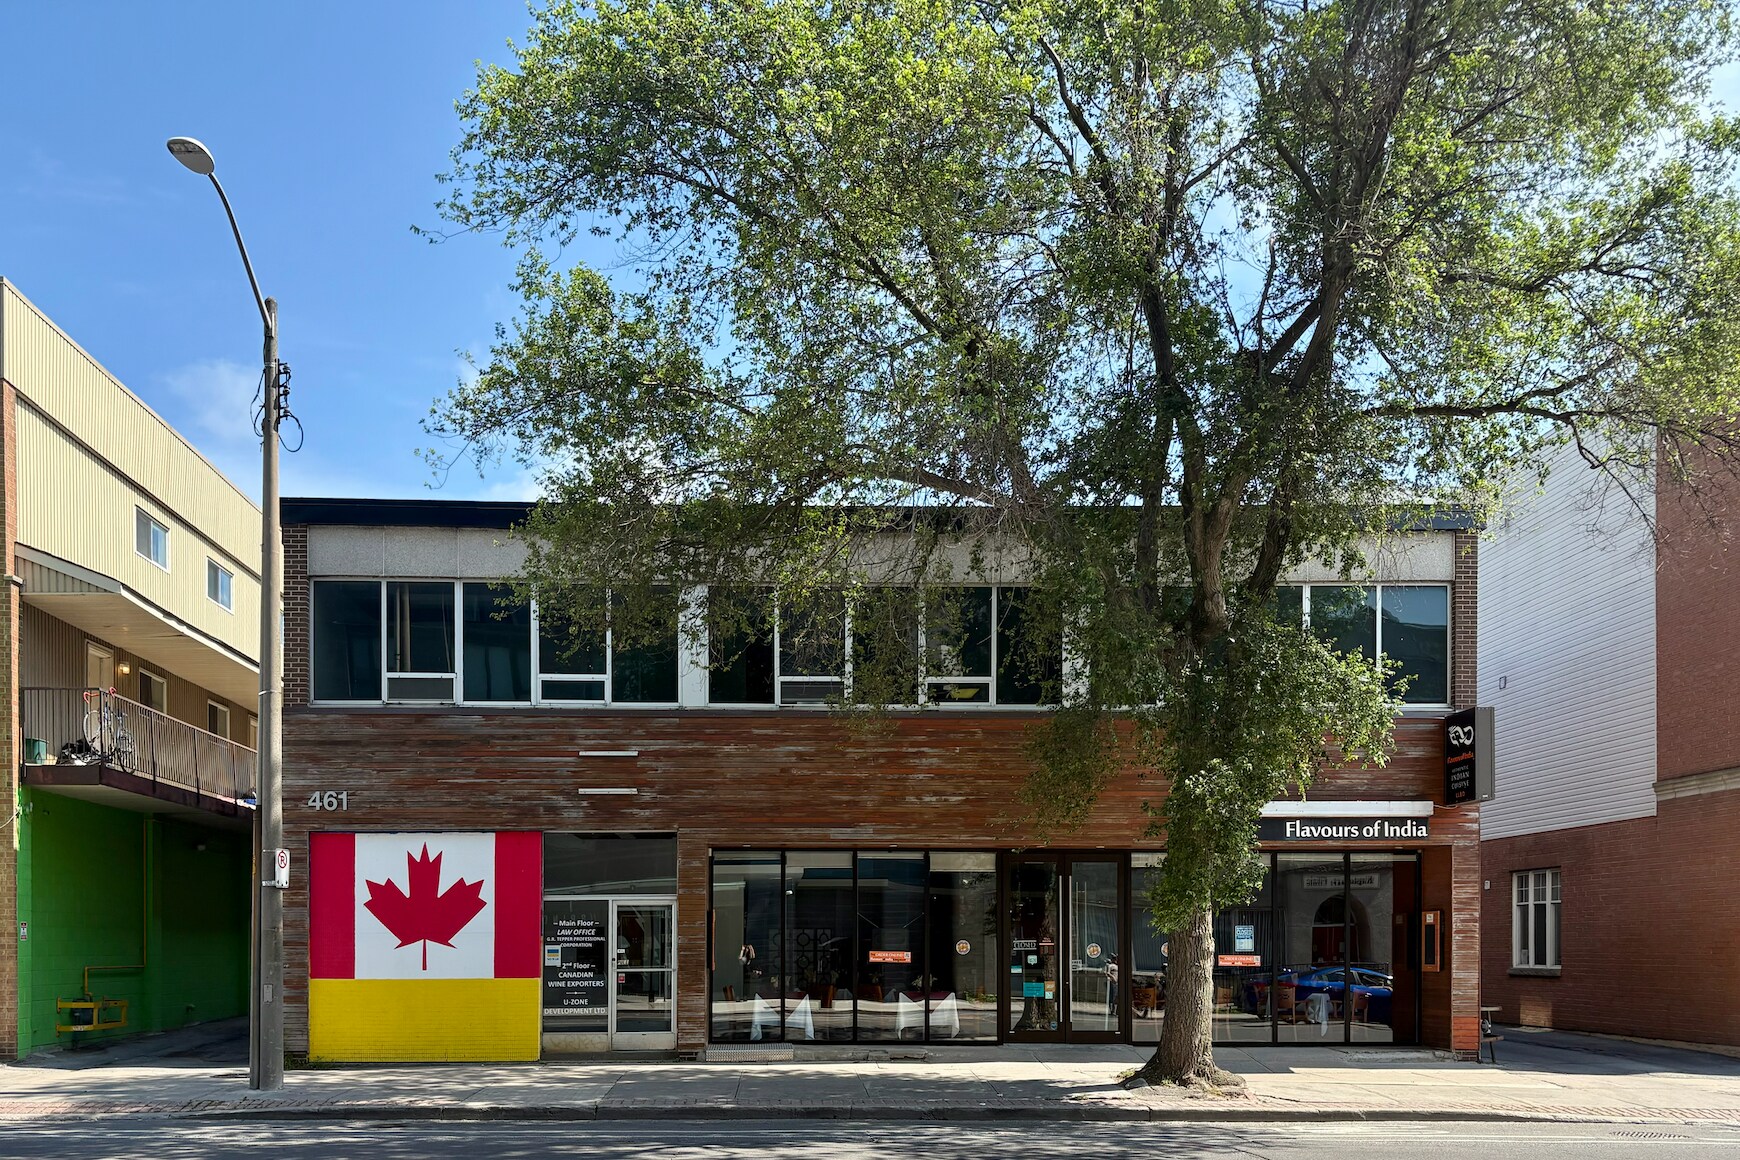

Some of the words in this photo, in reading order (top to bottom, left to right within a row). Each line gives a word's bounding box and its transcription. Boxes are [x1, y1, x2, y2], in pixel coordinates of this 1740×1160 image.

[307, 791, 348, 811] 461
[1285, 820, 1359, 838] Flavours
[1362, 820, 1382, 838] of
[1384, 820, 1428, 838] India
[1013, 941, 1037, 949] CLOSED
